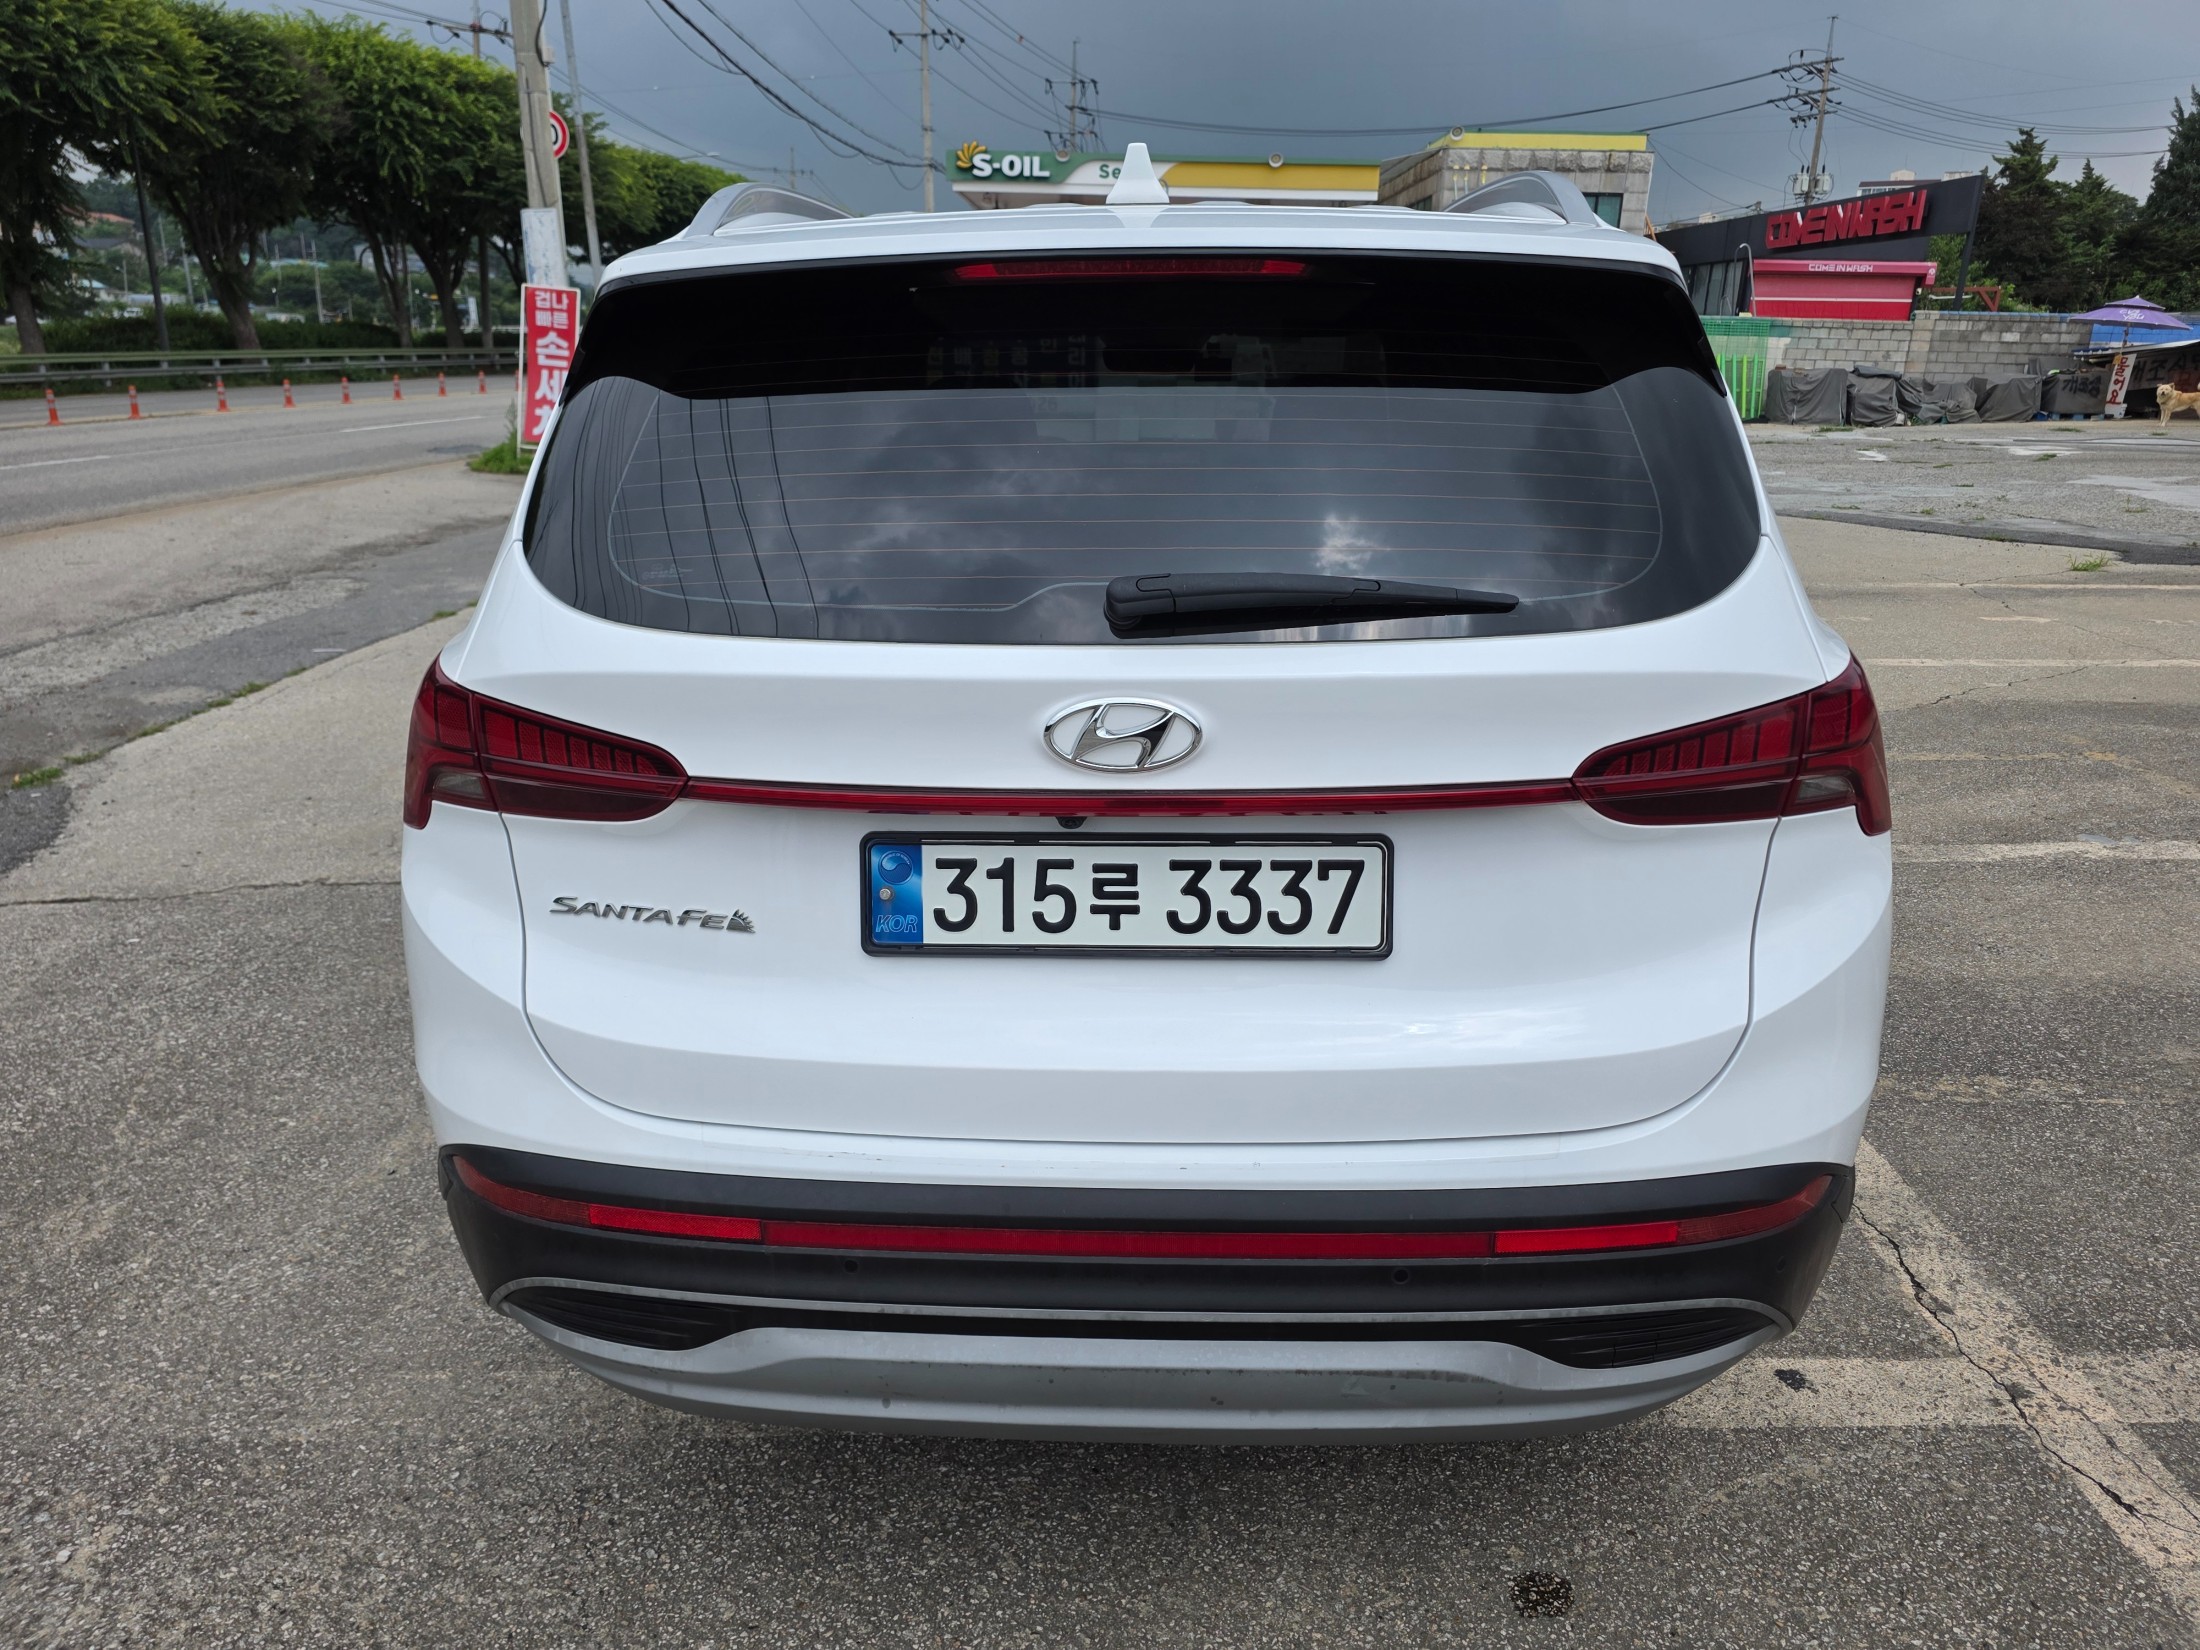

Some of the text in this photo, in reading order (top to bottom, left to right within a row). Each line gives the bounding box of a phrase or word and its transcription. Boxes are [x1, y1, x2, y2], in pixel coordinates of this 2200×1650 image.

[971, 153, 1050, 178] S-OIL
[1098, 163, 1121, 180] Se
[1848, 189, 1928, 238] WASH
[933, 857, 1366, 934] 315루 3337
[875, 914, 918, 933] KOR
